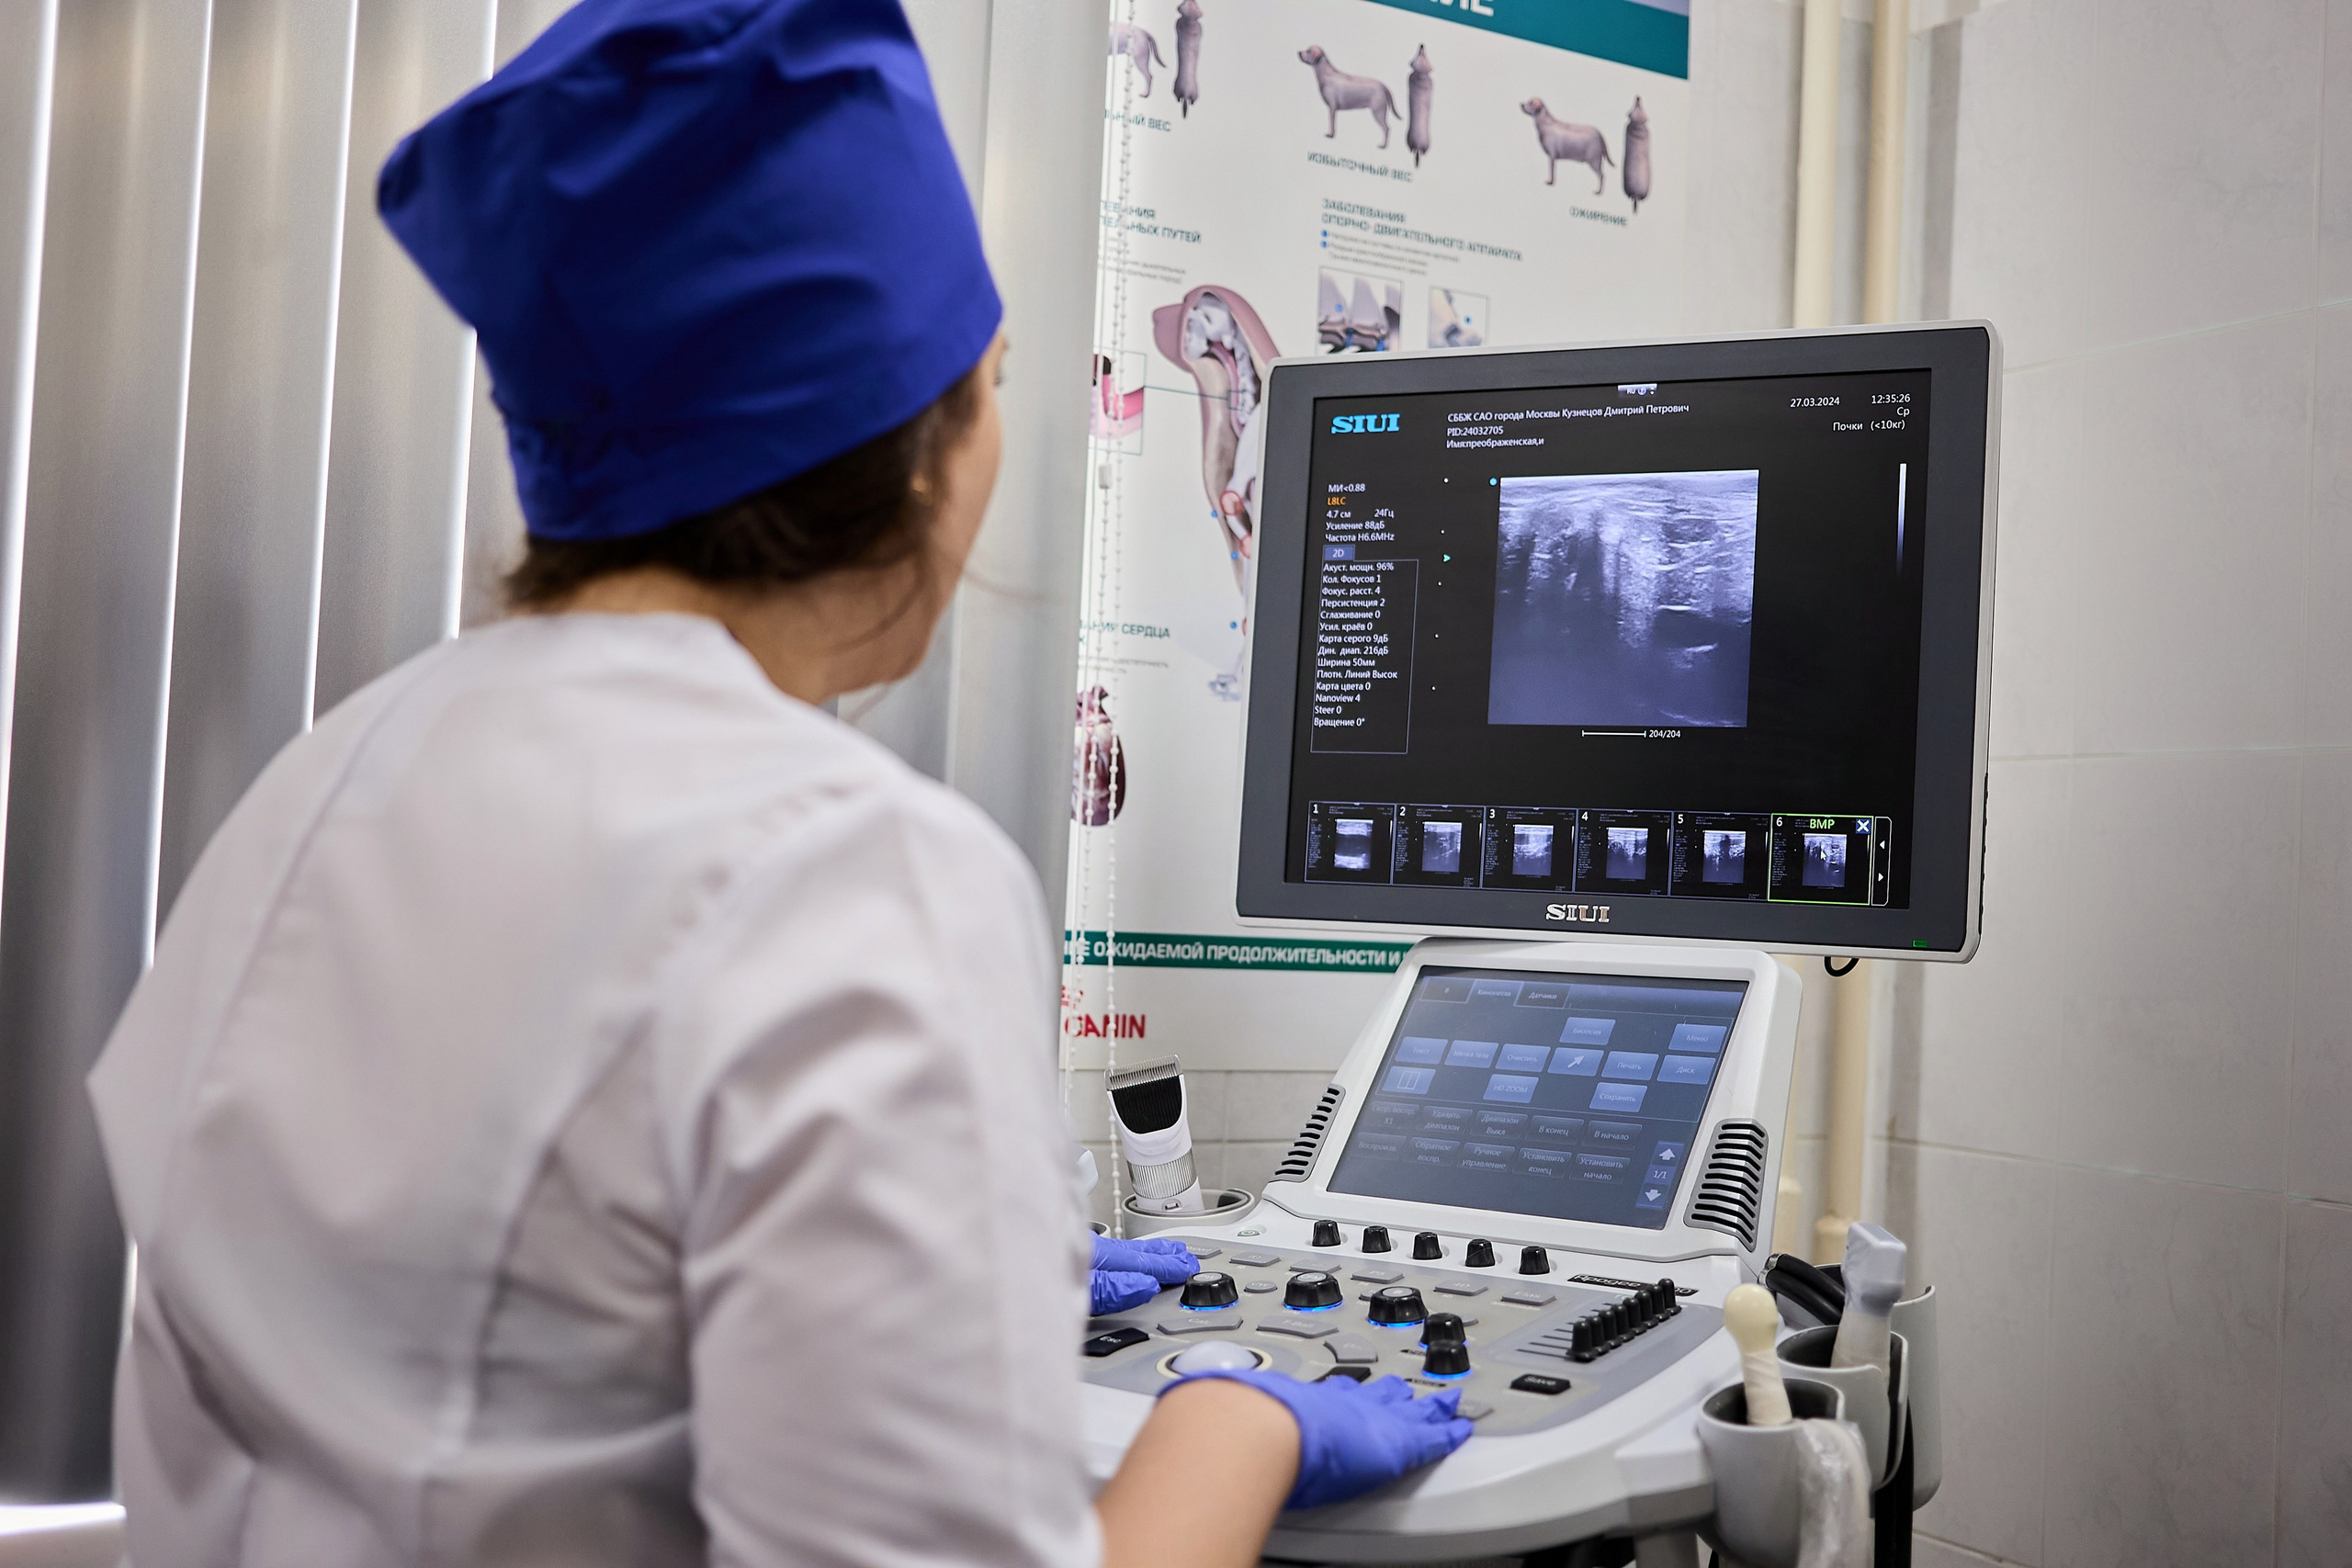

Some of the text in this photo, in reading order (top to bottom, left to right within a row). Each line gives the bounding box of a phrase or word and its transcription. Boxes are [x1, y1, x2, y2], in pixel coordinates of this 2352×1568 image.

[1790, 397, 1840, 408] 27.03.2024
[1871, 393, 1911, 404] 12:35:26
[1474, 412, 1492, 421] САО
[1494, 412, 1523, 423] города
[1525, 410, 1560, 419] Москвы
[1562, 408, 1602, 419] Кузнецов
[1604, 405, 1645, 417] Дмитрий
[1646, 404, 1689, 415] Петрович
[1896, 406, 1910, 417] Ср
[1330, 413, 1400, 434] SIUI
[1833, 422, 1863, 432] Почки
[1327, 510, 1339, 518] 4.7
[1374, 509, 1395, 518] 24Гц
[1326, 522, 1363, 531] Усиление
[1325, 534, 1356, 542] Частота
[1332, 549, 1344, 558] 2D
[1376, 562, 1395, 571] 96%
[1340, 575, 1374, 584] Фокусов
[1374, 586, 1380, 595] 4
[1321, 598, 1385, 608] Персистенция 2
[1320, 610, 1380, 619] Сглаживание 0
[1122, 623, 1170, 638] СЕРДЦА
[1367, 622, 1373, 630] 0
[1319, 634, 1388, 644] Карта серого 9дБ
[1363, 646, 1389, 656] 216дБ
[1317, 658, 1374, 668] Ширина 50мм
[1345, 670, 1371, 678] Линий
[1316, 682, 1371, 692] Карта цвета 0
[1314, 705, 1341, 715] Steer 0
[1314, 718, 1354, 728] Вращение
[1648, 729, 1681, 739] 204/204
[1312, 804, 1319, 814] 1
[1399, 807, 1406, 817] 2
[1489, 808, 1496, 819] 3
[1581, 811, 1589, 821] 4
[1678, 814, 1683, 825] 5
[1776, 817, 1782, 827] 6
[1810, 818, 1836, 829] BMP
[1545, 904, 1610, 922] SIUI
[1093, 941, 1204, 961] ОЖИДАЕМОЙ
[1207, 944, 1385, 965] ПРОДОЛЖИТЕЛЬНОСТИ
[1573, 1027, 1602, 1036] Биопсия
[1686, 1034, 1709, 1043] Меню
[1617, 1062, 1642, 1071] Печать
[1676, 1066, 1696, 1075] Диск
[1600, 1093, 1637, 1103] Сохранить
[1481, 1113, 1520, 1124] Диапазон
[1486, 1126, 1506, 1135] Выкл
[1545, 1128, 1569, 1136] конец
[1600, 1133, 1630, 1141] начало
[1415, 1141, 1452, 1152] Обратное
[1474, 1146, 1501, 1156] Ручное
[1521, 1152, 1566, 1163] Установить
[1578, 1157, 1623, 1168] Установить
[1461, 1159, 1507, 1170] управление
[1528, 1167, 1553, 1175] конец
[1584, 1172, 1611, 1180] начало
[1654, 1170, 1667, 1179] 1/1
[1574, 1275, 1641, 1288] Apogee
